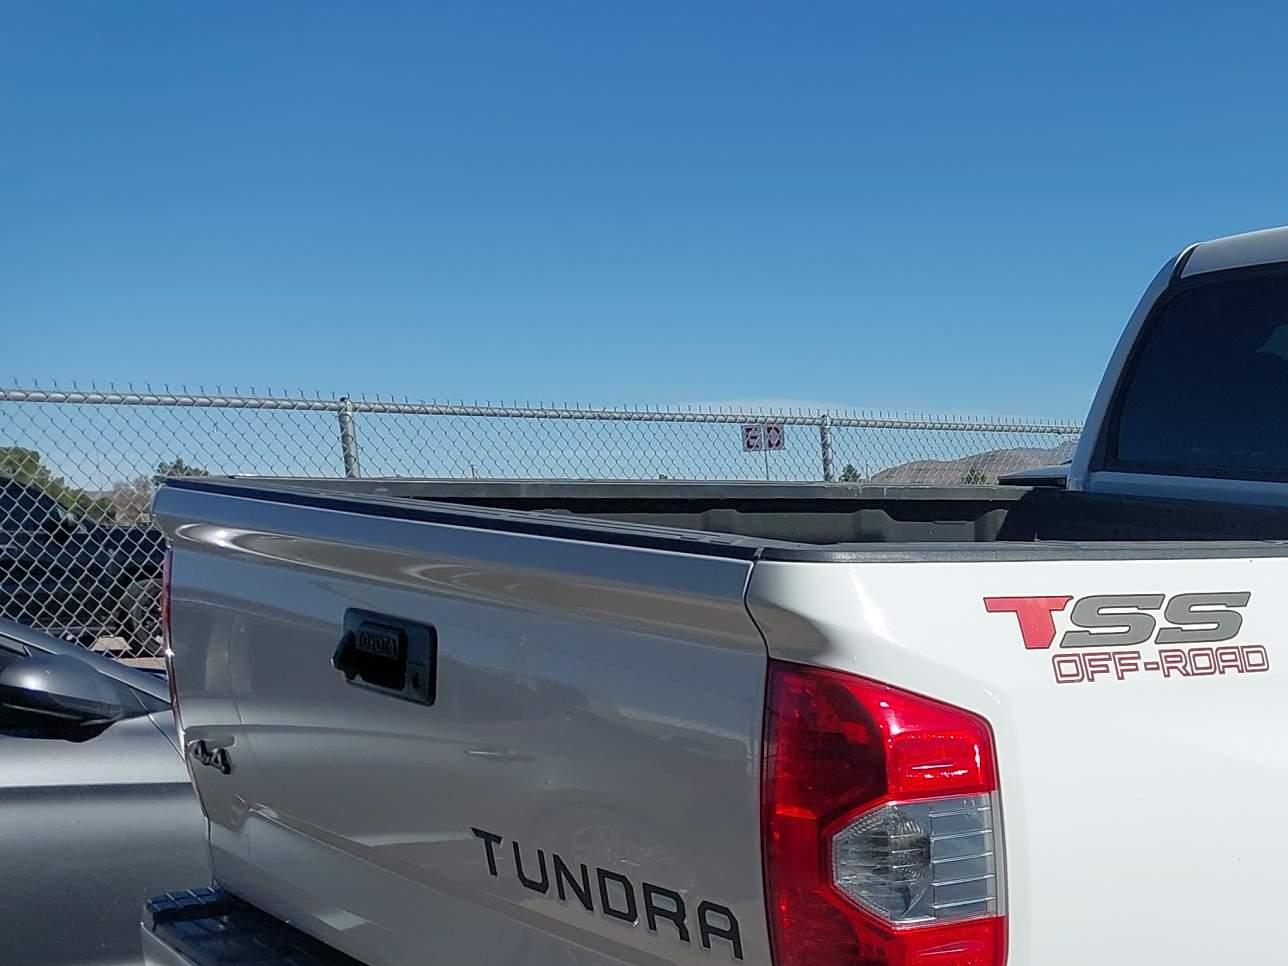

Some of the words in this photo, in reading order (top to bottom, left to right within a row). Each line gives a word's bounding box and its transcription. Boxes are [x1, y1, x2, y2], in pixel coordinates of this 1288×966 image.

[983, 592, 1251, 649] TSS
[1052, 645, 1269, 684] OFF-ROAD
[470, 827, 744, 960] TUNDRA
